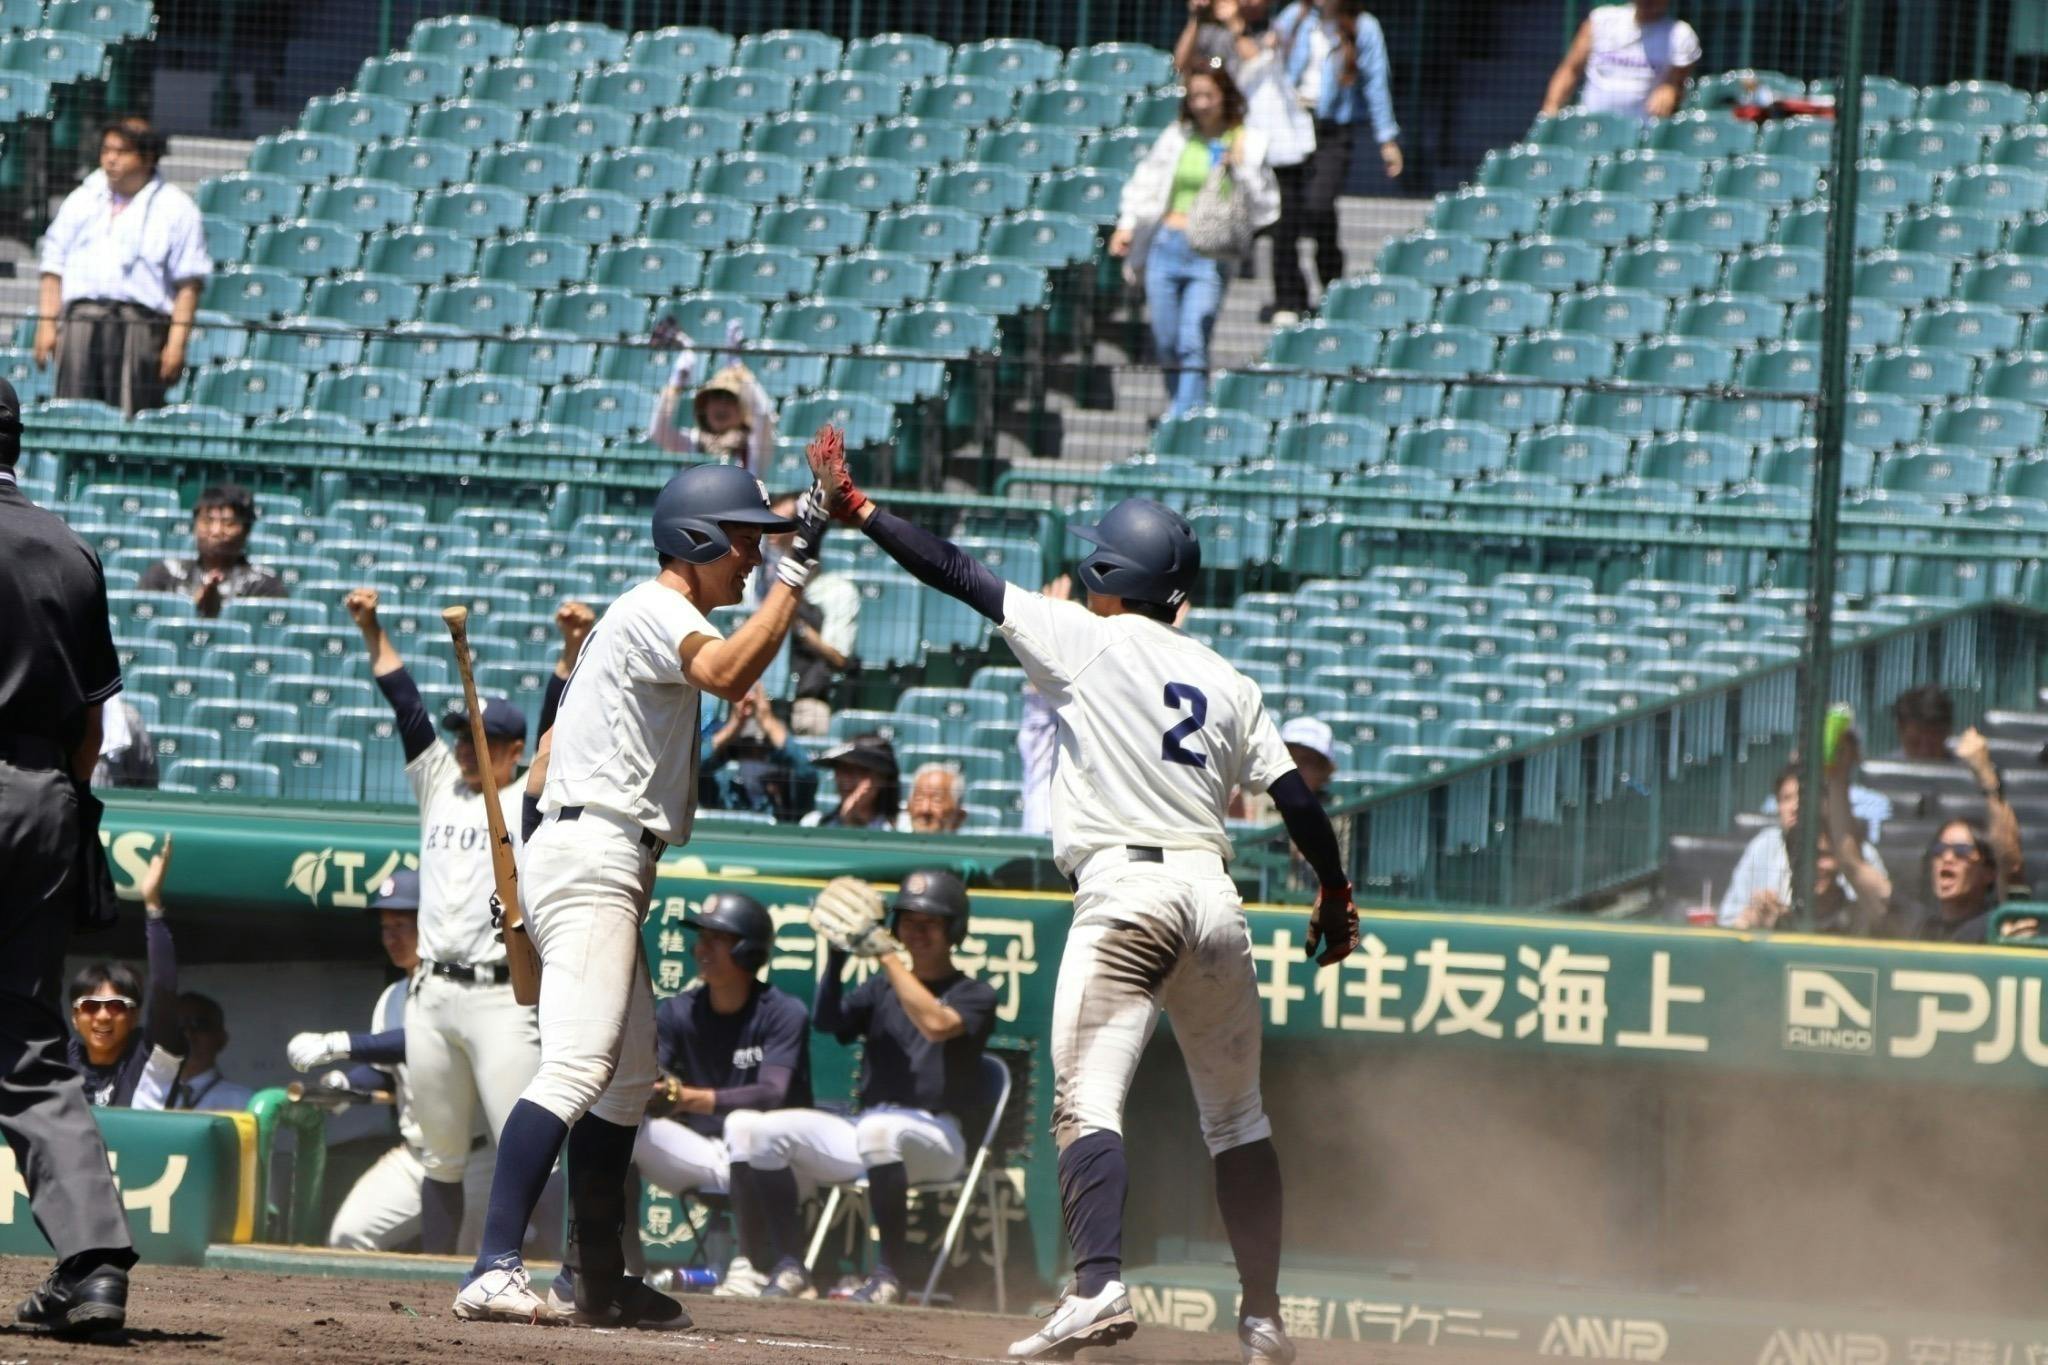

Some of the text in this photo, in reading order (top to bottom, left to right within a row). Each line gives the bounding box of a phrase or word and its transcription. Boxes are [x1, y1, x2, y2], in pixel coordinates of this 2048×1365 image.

[1161, 681, 1208, 769] 2
[426, 825, 514, 851] KYOT
[1788, 1026, 1872, 1050] ALINCO
